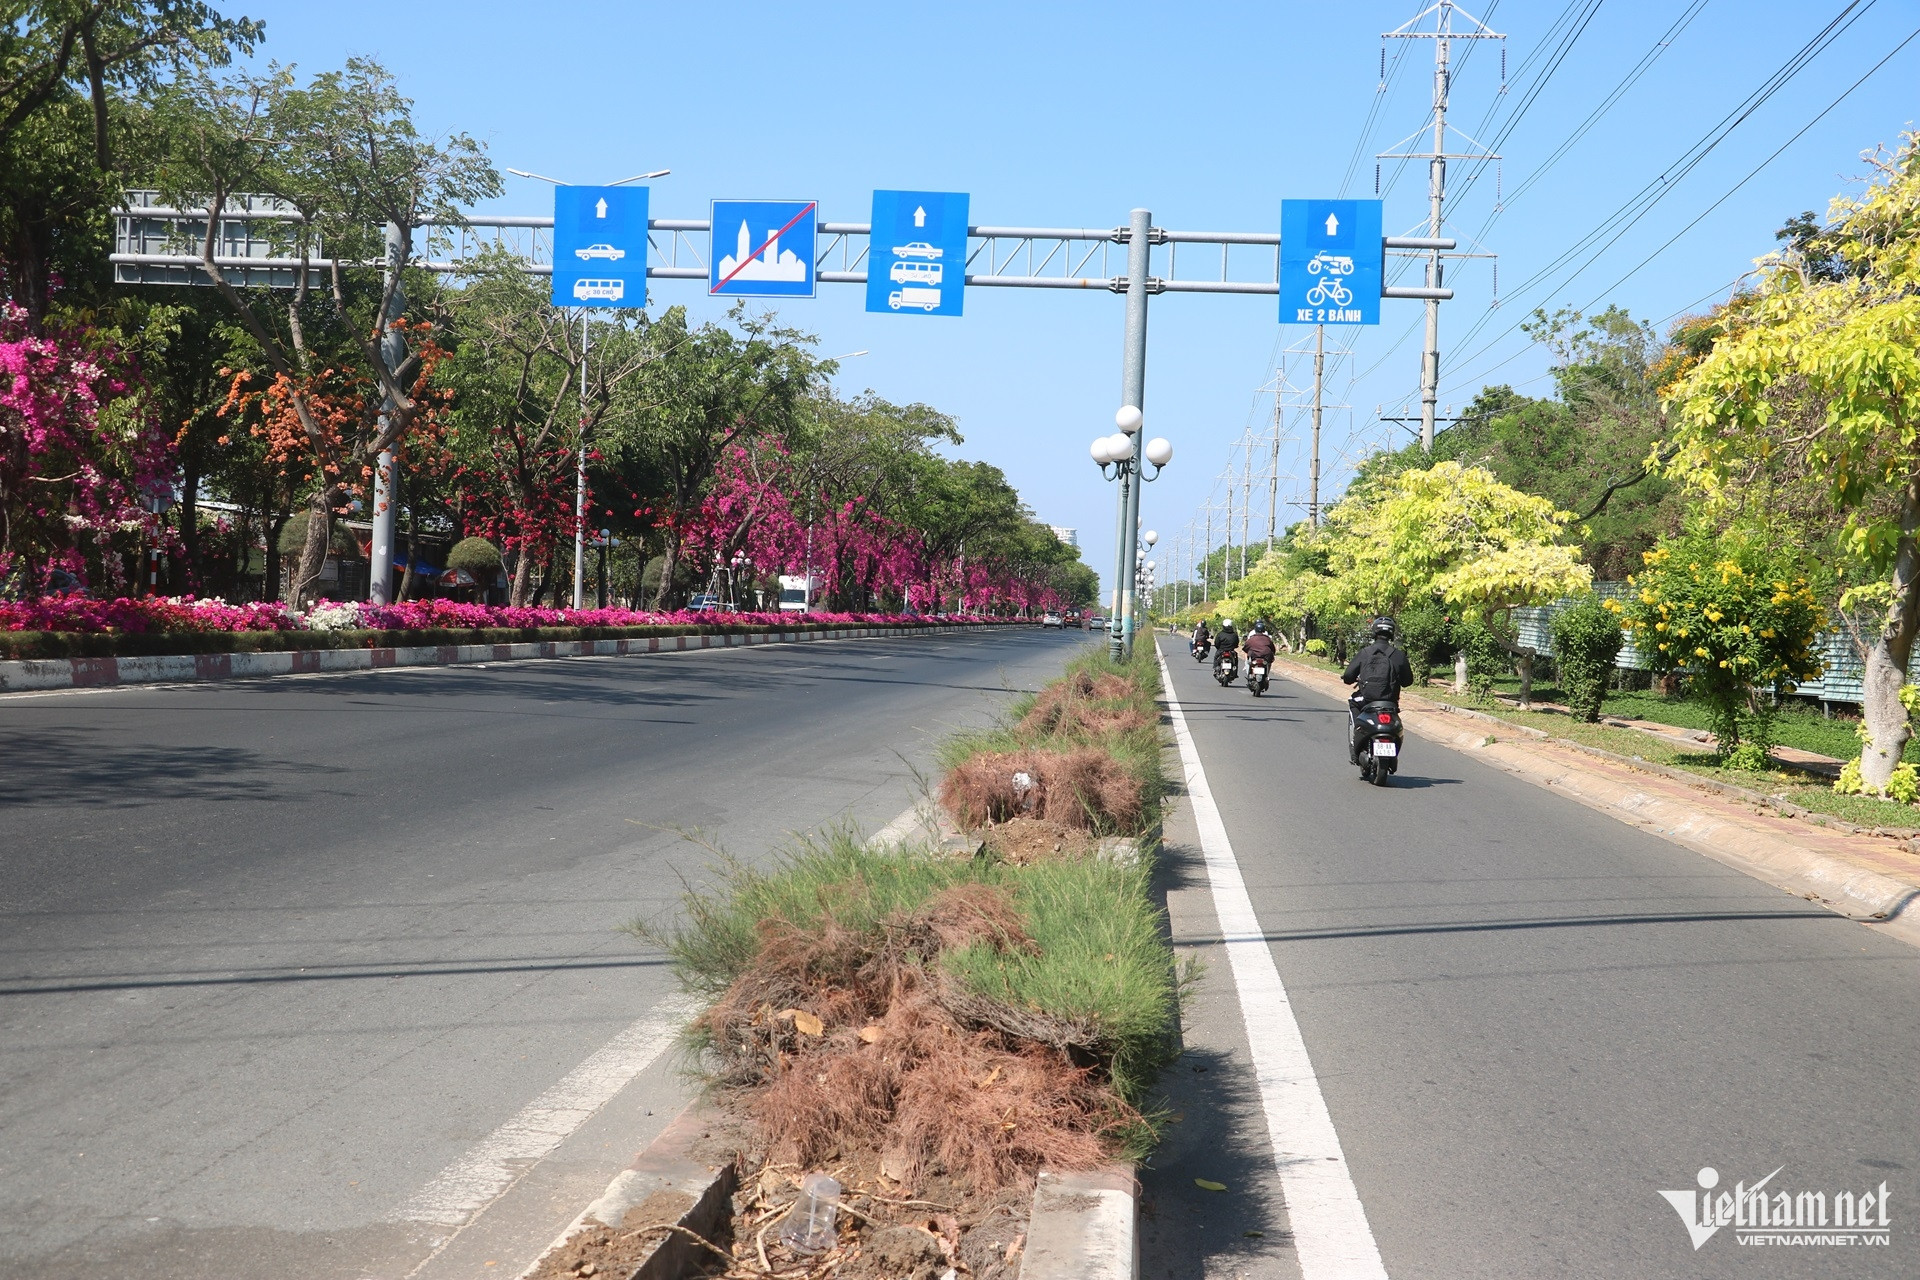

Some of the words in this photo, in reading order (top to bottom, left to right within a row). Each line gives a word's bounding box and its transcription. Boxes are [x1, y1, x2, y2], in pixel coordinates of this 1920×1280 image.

[1297, 309, 1313, 321] XE
[1317, 309, 1325, 321] 2
[1328, 307, 1361, 322] BÁNH
